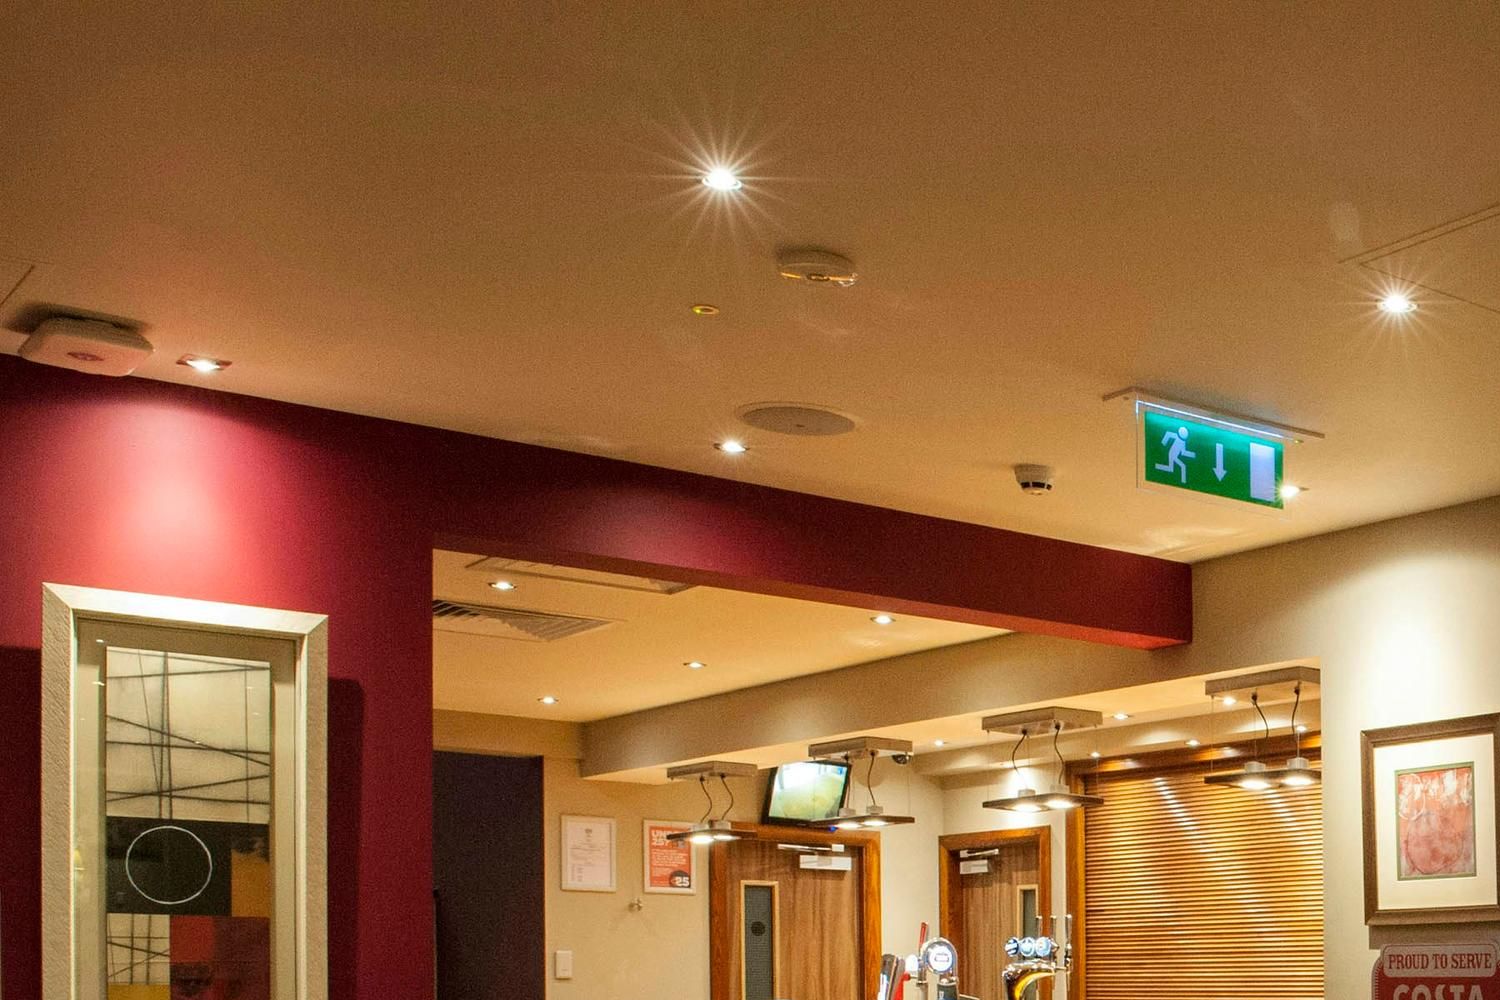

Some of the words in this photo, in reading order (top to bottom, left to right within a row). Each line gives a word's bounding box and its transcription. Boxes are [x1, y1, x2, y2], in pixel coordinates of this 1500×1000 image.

[1388, 953, 1429, 970] PROUD
[1432, 953, 1448, 969] TO
[1450, 952, 1492, 969] SERVE
